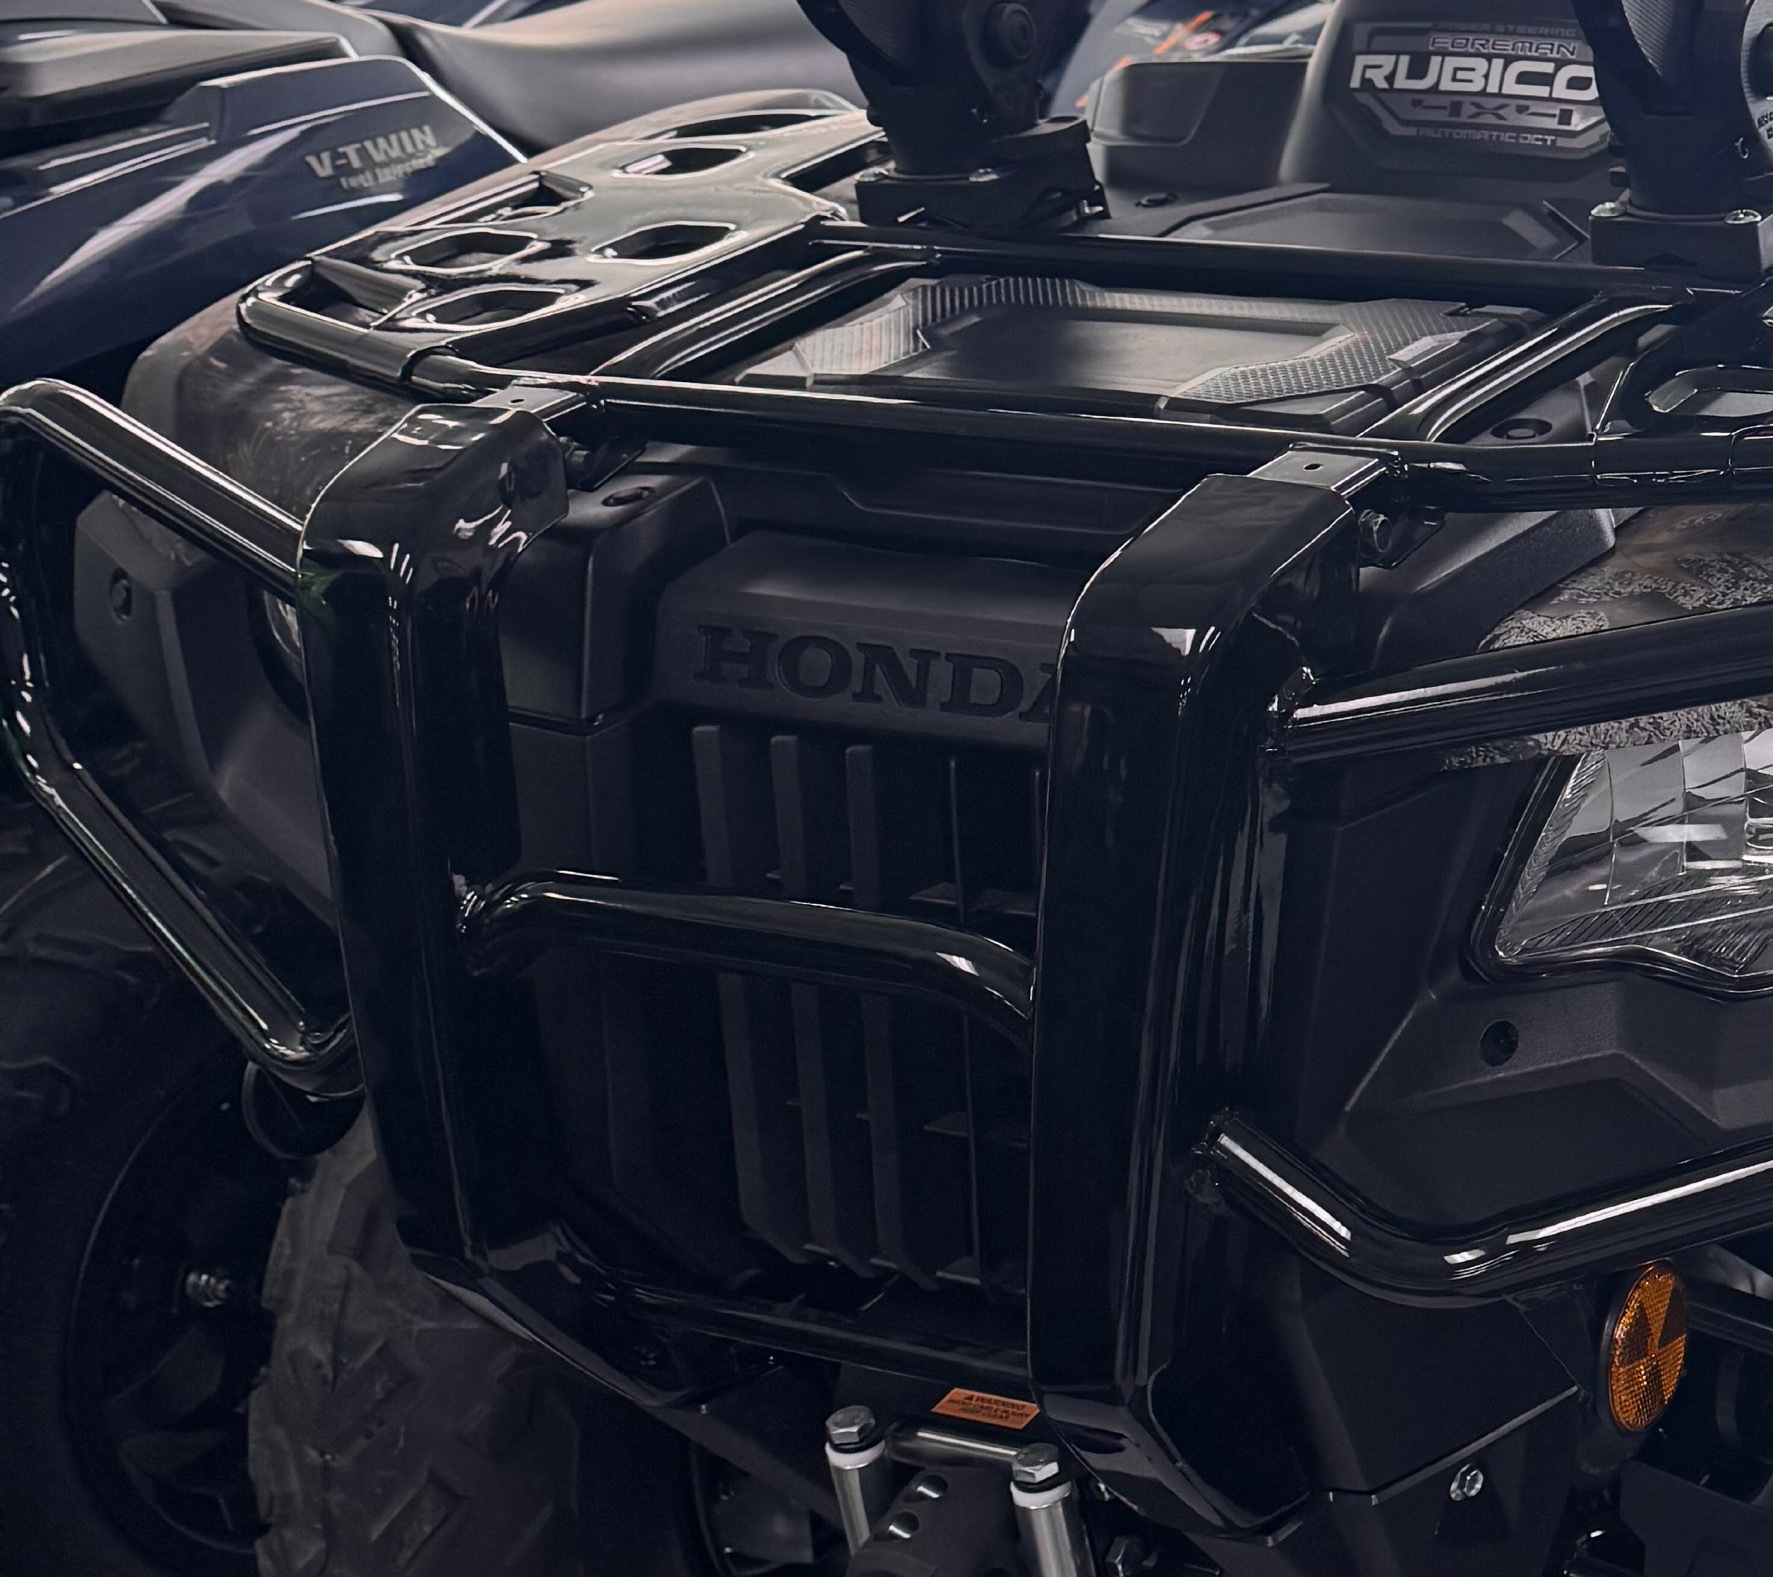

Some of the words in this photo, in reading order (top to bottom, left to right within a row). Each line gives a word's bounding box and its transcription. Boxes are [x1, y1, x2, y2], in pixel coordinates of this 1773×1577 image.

[1429, 35, 1577, 59] FOREMAN
[1350, 54, 1600, 101] RUBICO
[304, 125, 437, 179] V-TWIN
[1418, 128, 1516, 143] AUTOMATIC
[1518, 134, 1556, 146] DCT
